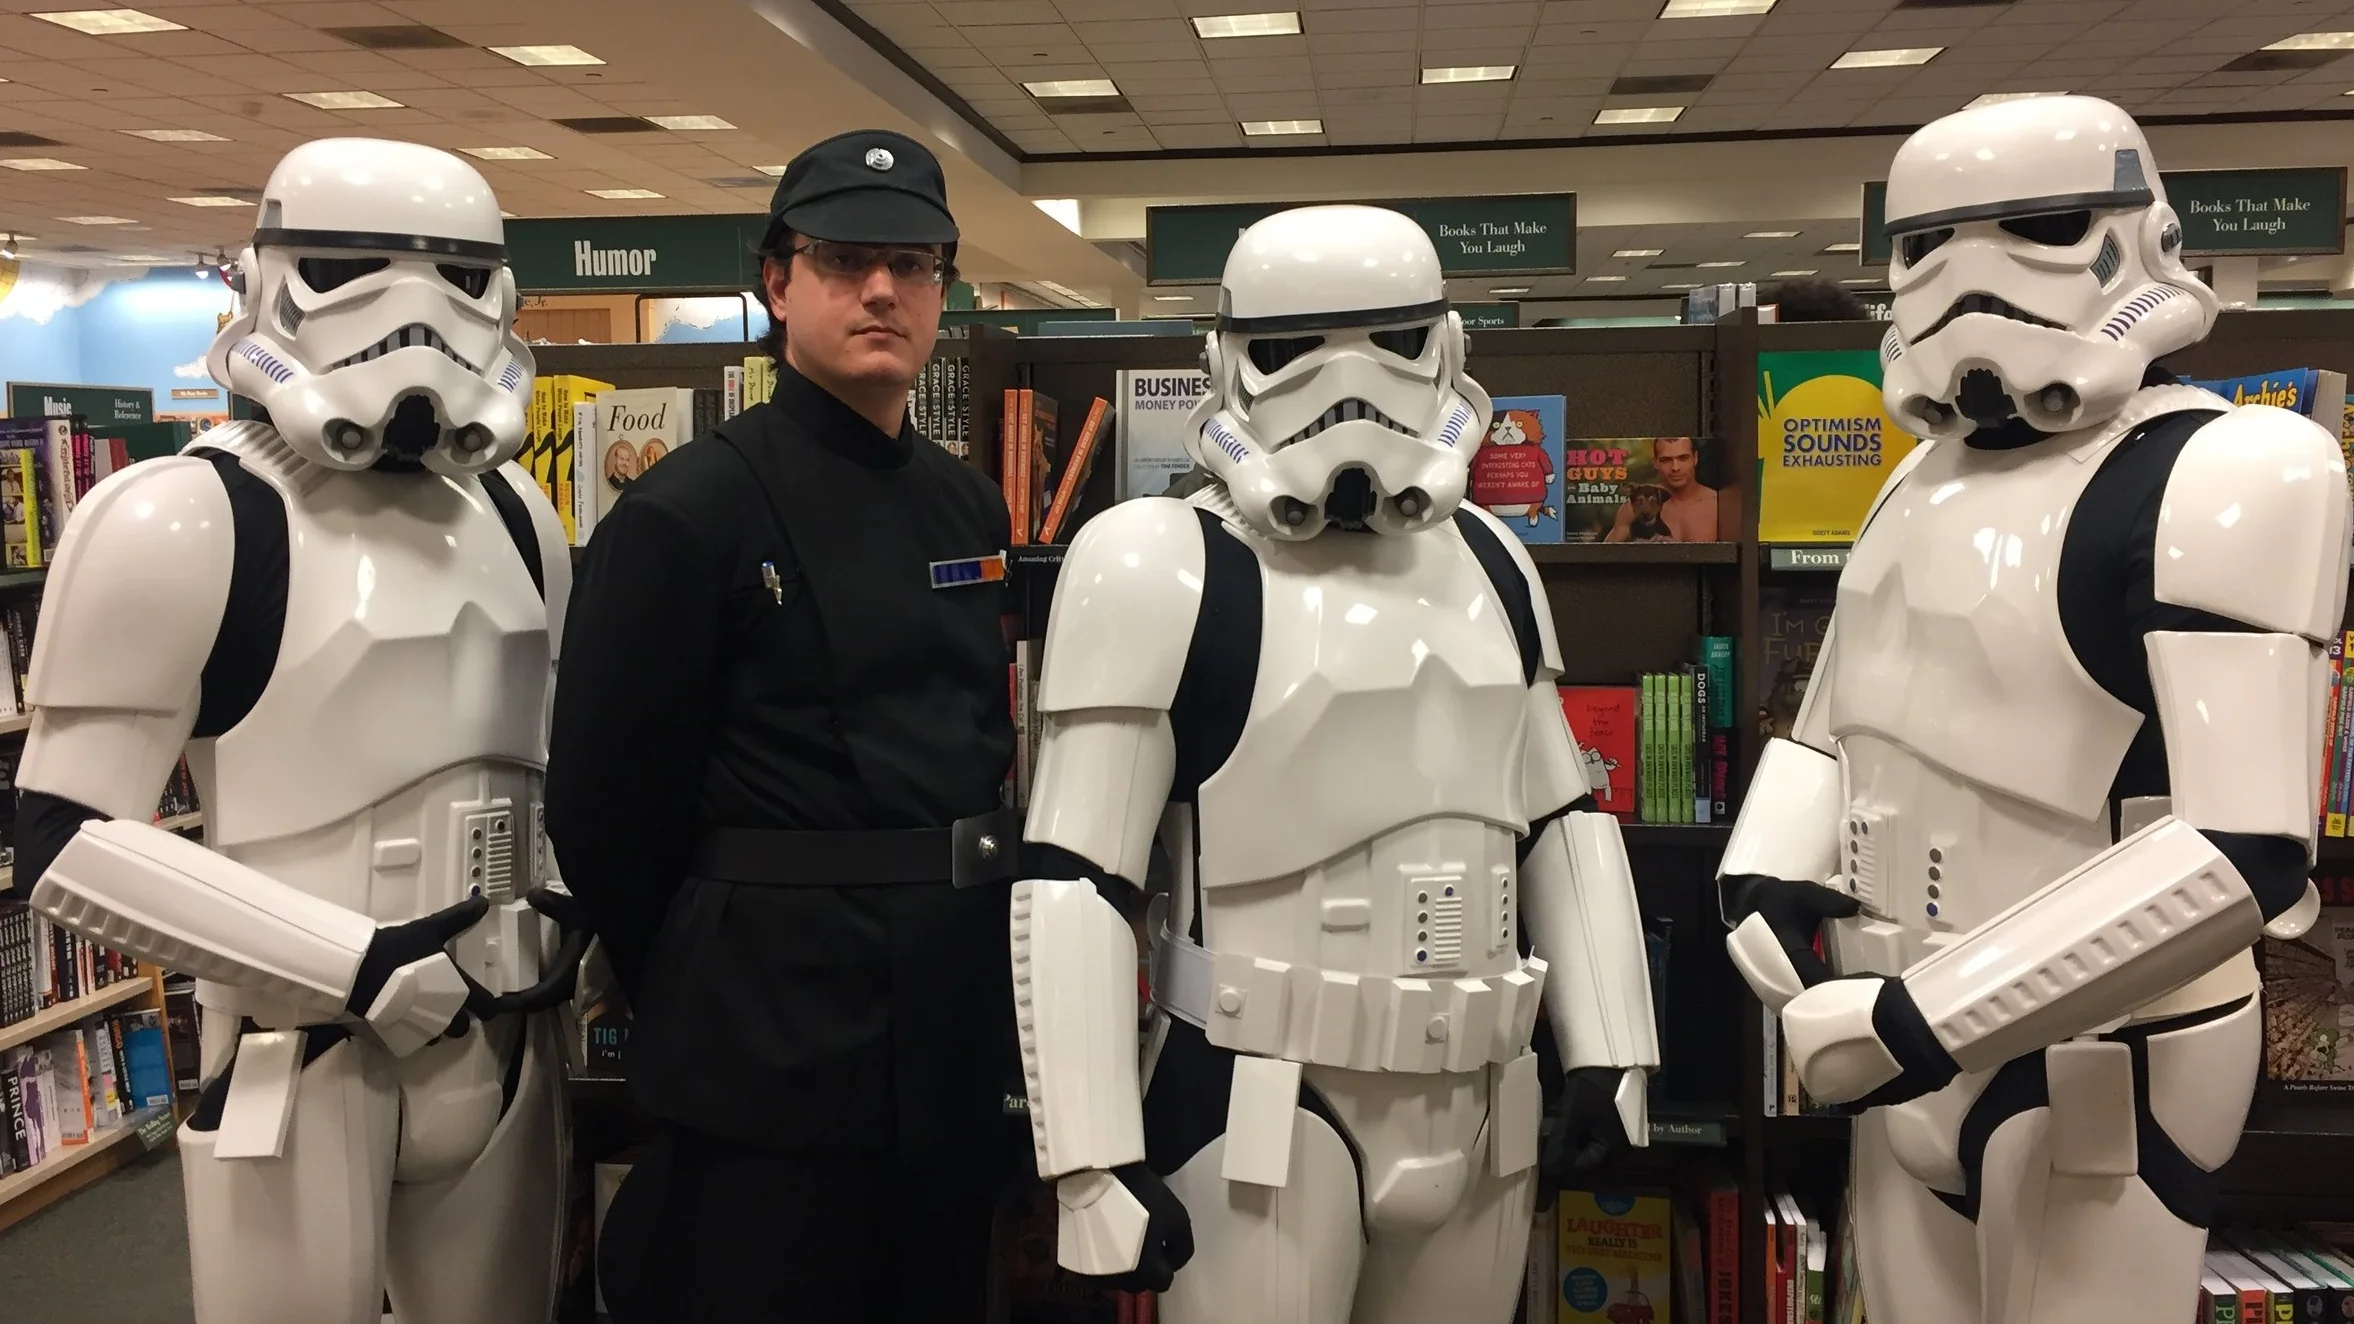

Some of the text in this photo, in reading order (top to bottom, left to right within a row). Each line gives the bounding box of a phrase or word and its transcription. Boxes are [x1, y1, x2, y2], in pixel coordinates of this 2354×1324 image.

[2190, 198, 2311, 214] Books That Make
[1440, 221, 1548, 237] Books That Make
[2213, 217, 2286, 234] You Laugh
[1460, 240, 1525, 256] You Laugh
[574, 240, 657, 277] Humor
[1478, 316, 1504, 328] Sports
[918, 366, 926, 399] RACE
[1134, 377, 1211, 397] BUSINES
[932, 363, 940, 436] GRACE STYLE
[947, 364, 956, 436] GRACE STYLE
[962, 364, 970, 436] GRACE STYLE
[2233, 380, 2297, 408] Archie's
[44, 396, 72, 417] Music
[114, 398, 134, 412] History
[1135, 400, 1199, 410] MONEY PO
[114, 409, 142, 420] Reference
[607, 402, 667, 432] Food
[1784, 418, 1881, 432] OPTIMISM
[1784, 433, 1882, 453] SOUNDS
[1566, 450, 1627, 466] HOT
[1783, 454, 1882, 467] EXHAUSTING
[1567, 467, 1628, 480] GUYS
[1578, 483, 1618, 494] Baby
[1566, 495, 1628, 504] Animals
[1018, 555, 1047, 563] Amusing
[1791, 550, 1839, 564] From
[1772, 611, 1804, 636] I'M
[1697, 673, 1706, 704] DOGS
[1587, 703, 1620, 718] beyond
[1592, 717, 1608, 725] the
[593, 1027, 618, 1045] TIG
[7, 1076, 27, 1141] PRINCE
[1653, 1123, 1702, 1135] by Author
[1566, 1217, 1663, 1239] LAUGHTER
[1587, 1237, 1638, 1249] REALLY IS
